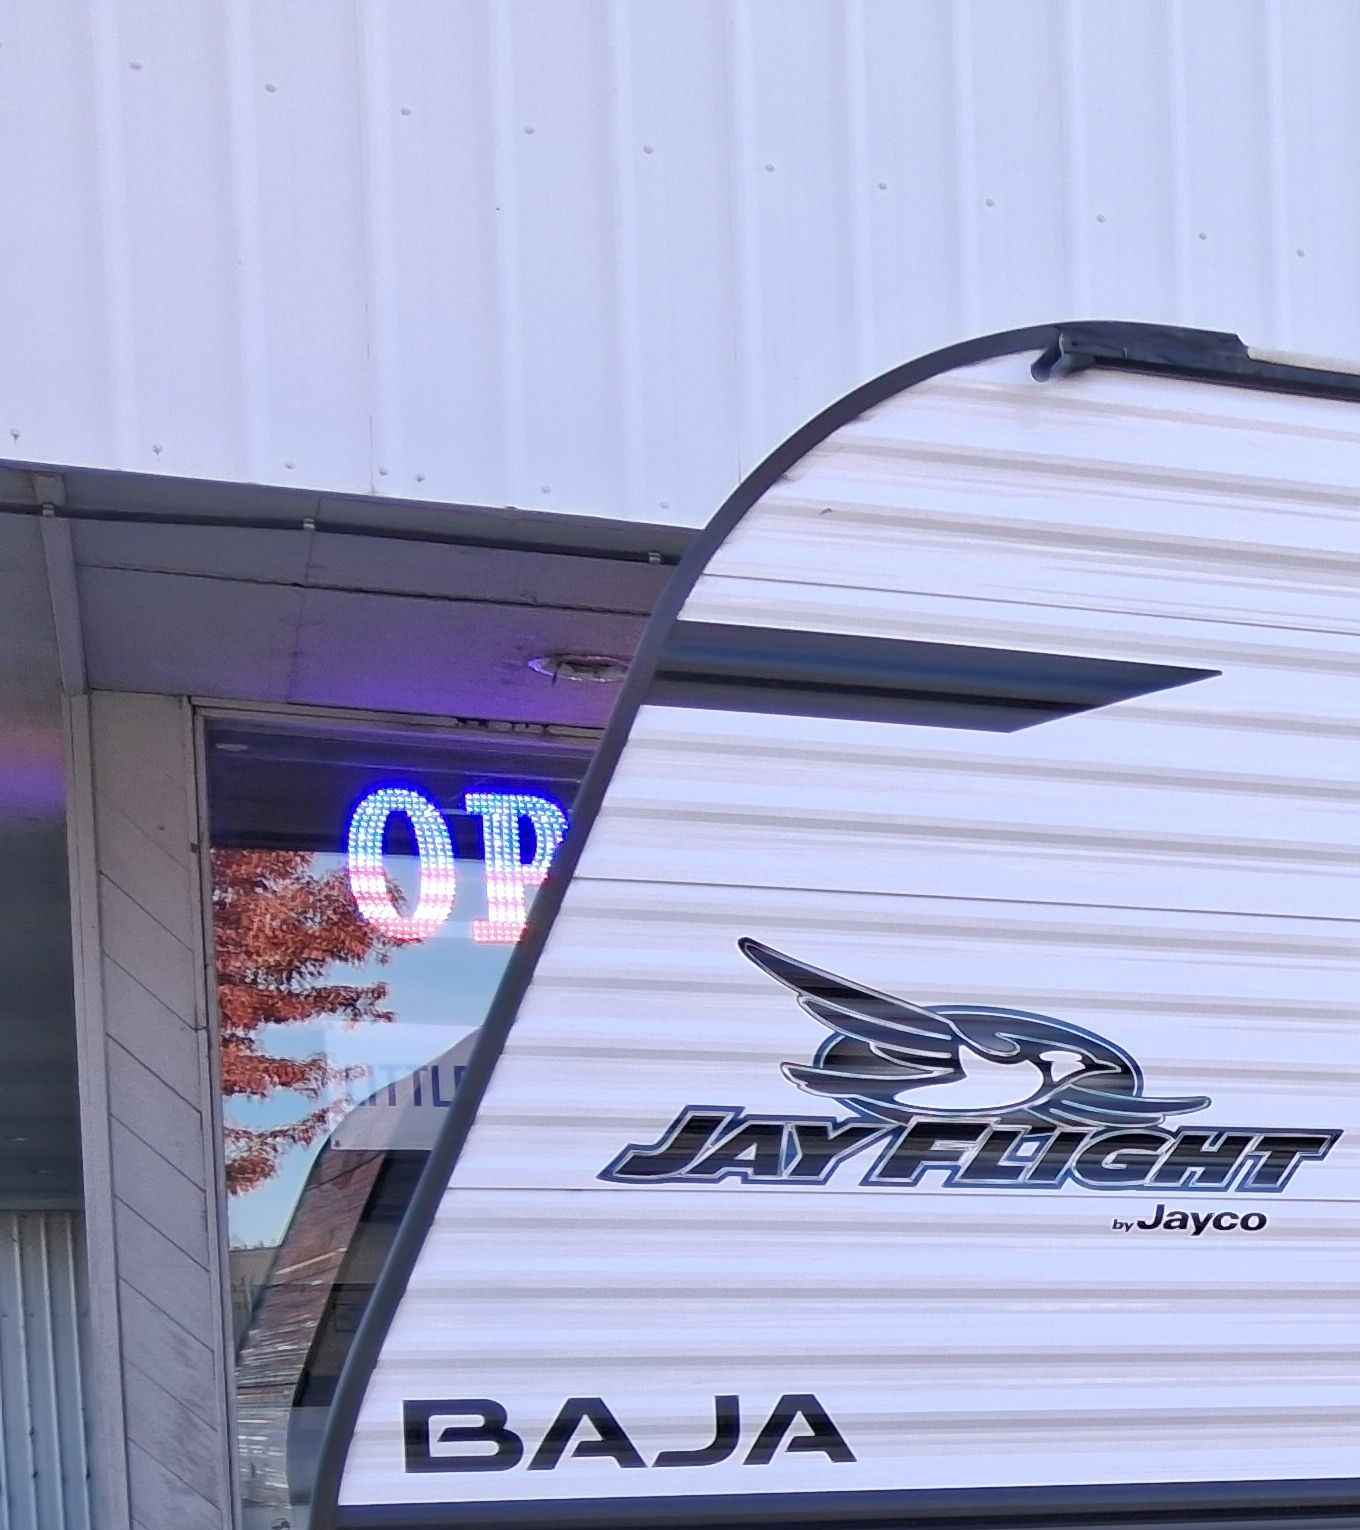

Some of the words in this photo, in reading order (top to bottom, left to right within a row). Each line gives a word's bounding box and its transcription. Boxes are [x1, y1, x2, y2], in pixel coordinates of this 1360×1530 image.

[597, 1105, 892, 1184] JAY
[859, 1115, 1344, 1191] FLIGHT
[1112, 1219, 1133, 1232] by
[1136, 1204, 1267, 1235] Jayco
[402, 1394, 857, 1473] BAJA
